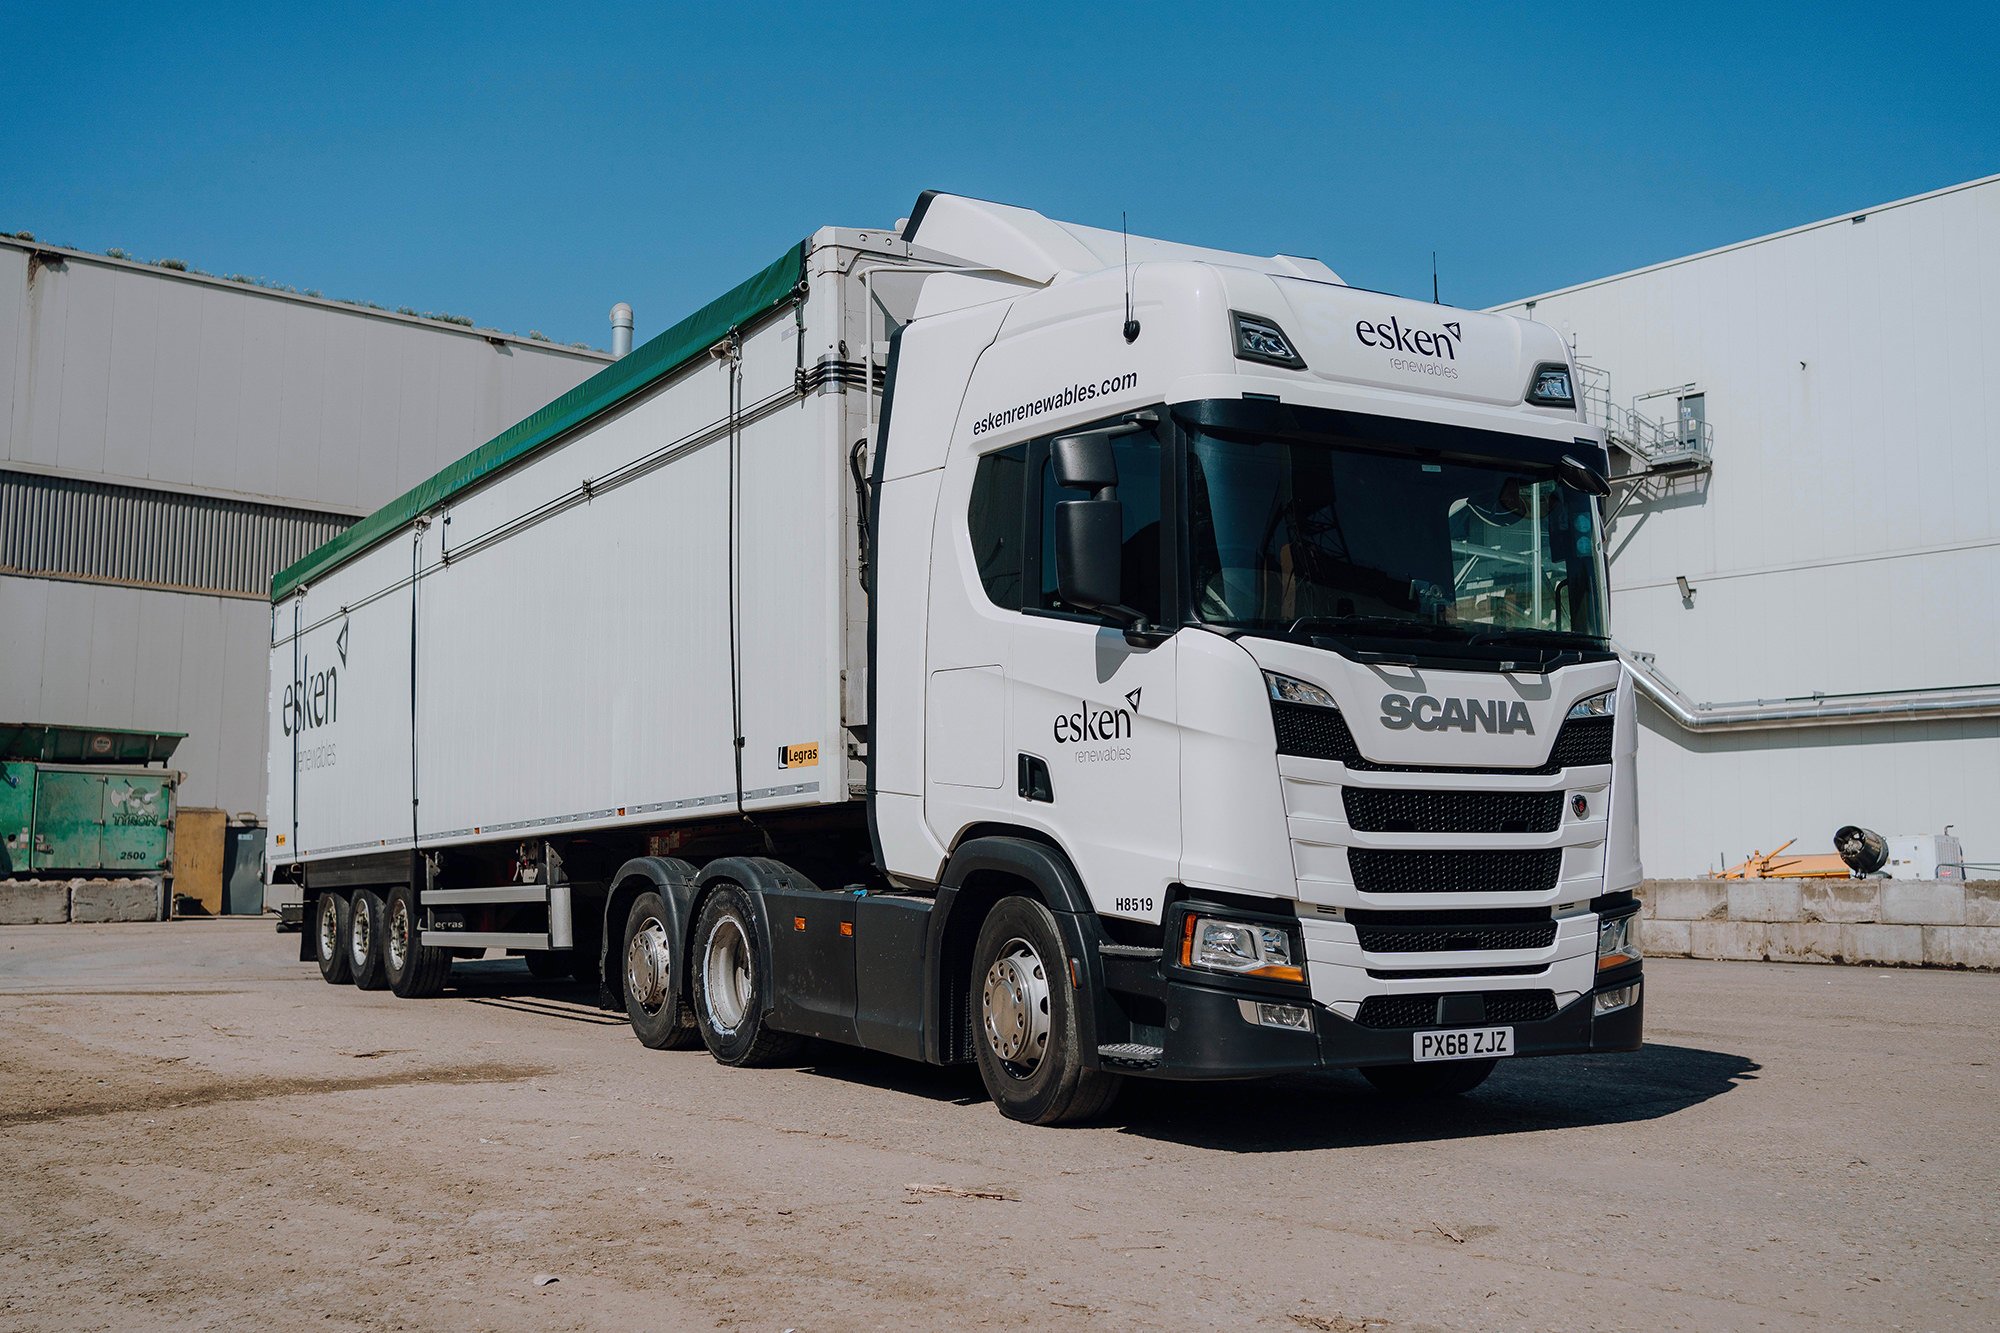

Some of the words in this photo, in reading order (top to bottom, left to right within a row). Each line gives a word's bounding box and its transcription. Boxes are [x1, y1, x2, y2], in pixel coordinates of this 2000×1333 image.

[1356, 316, 1455, 360] esken
[1389, 357, 1459, 380] renewables
[973, 371, 1138, 436] eskenrenewables.com
[283, 653, 337, 737] esken
[1053, 699, 1131, 744] esken
[1380, 693, 1536, 736] SCANIA
[789, 748, 818, 764] Legras
[1075, 746, 1132, 763] renewables
[112, 812, 159, 827] TYRON
[120, 851, 146, 861] 2500
[1115, 897, 1153, 912] H8519
[1422, 1033, 1468, 1057] PX68
[1473, 1031, 1507, 1054] ZJZ
